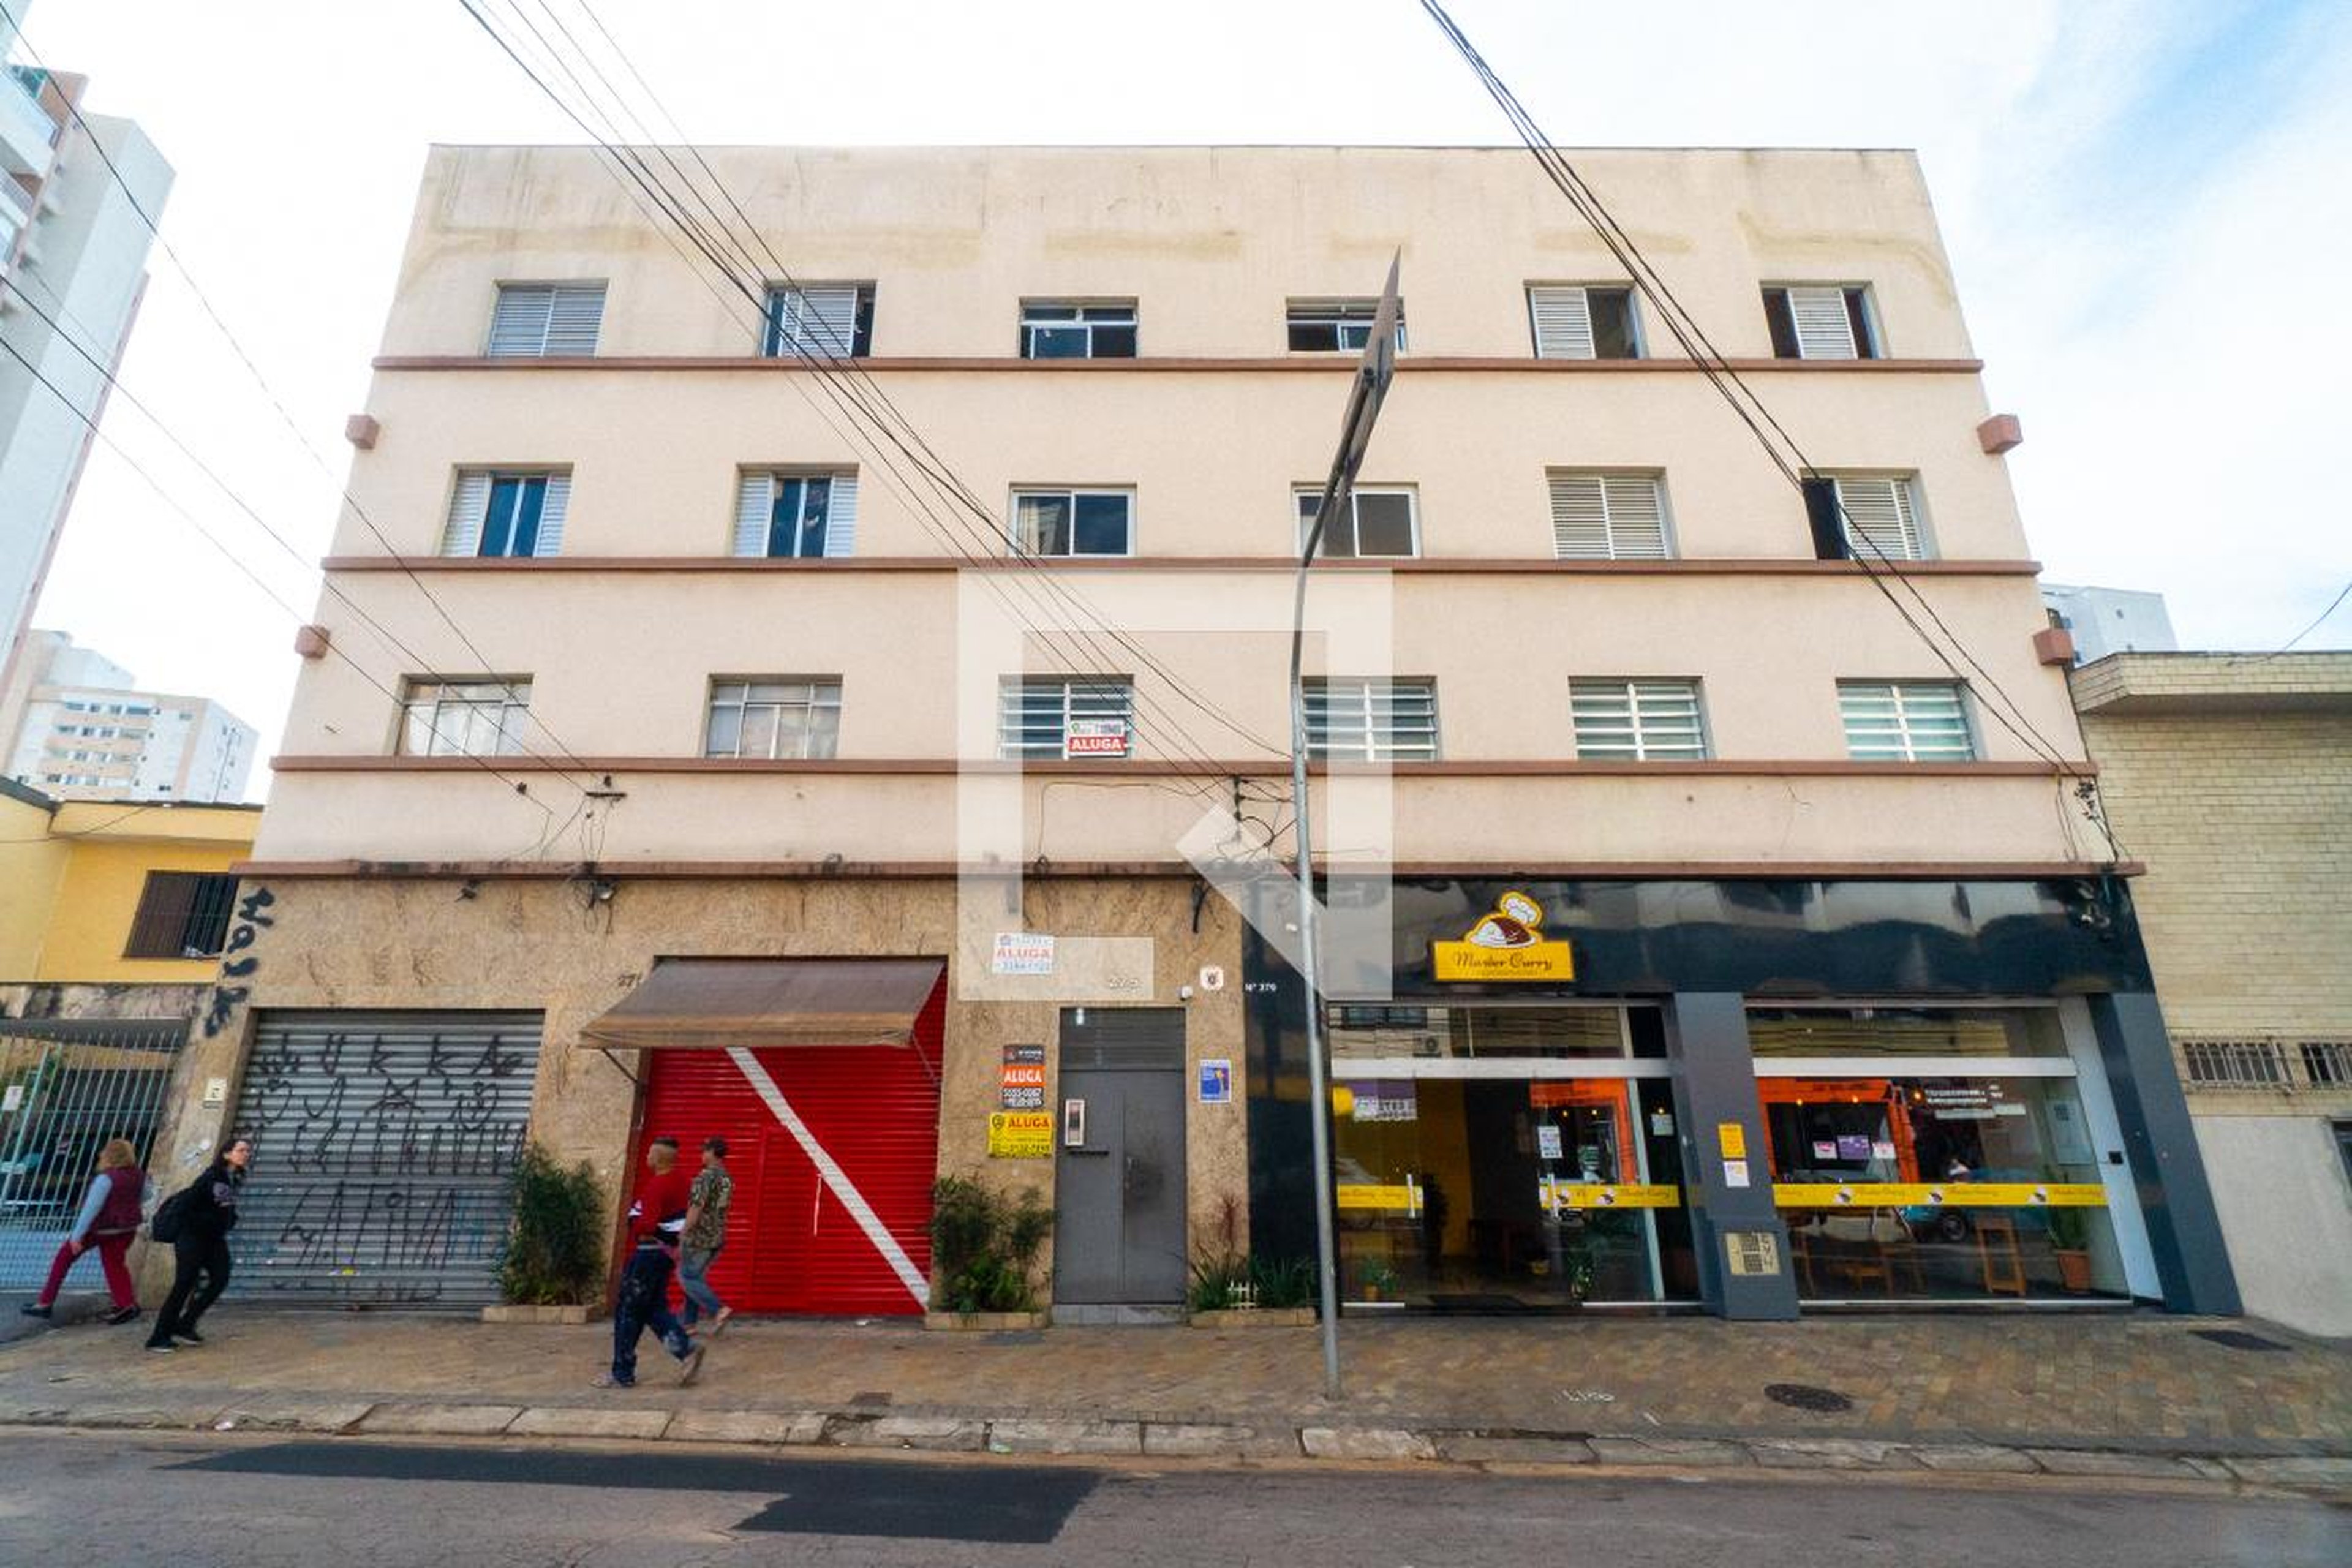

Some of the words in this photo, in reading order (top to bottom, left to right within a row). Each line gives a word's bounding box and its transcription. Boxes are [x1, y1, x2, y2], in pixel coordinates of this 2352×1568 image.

[1071, 738, 1123, 750] ALUGA
[997, 948, 1050, 958] ALUGA
[1454, 951, 1507, 967] Master
[1510, 952, 1553, 971] Curry
[1004, 1069, 1042, 1083] ALUGA
[1008, 1117, 1050, 1128] ALUGA
